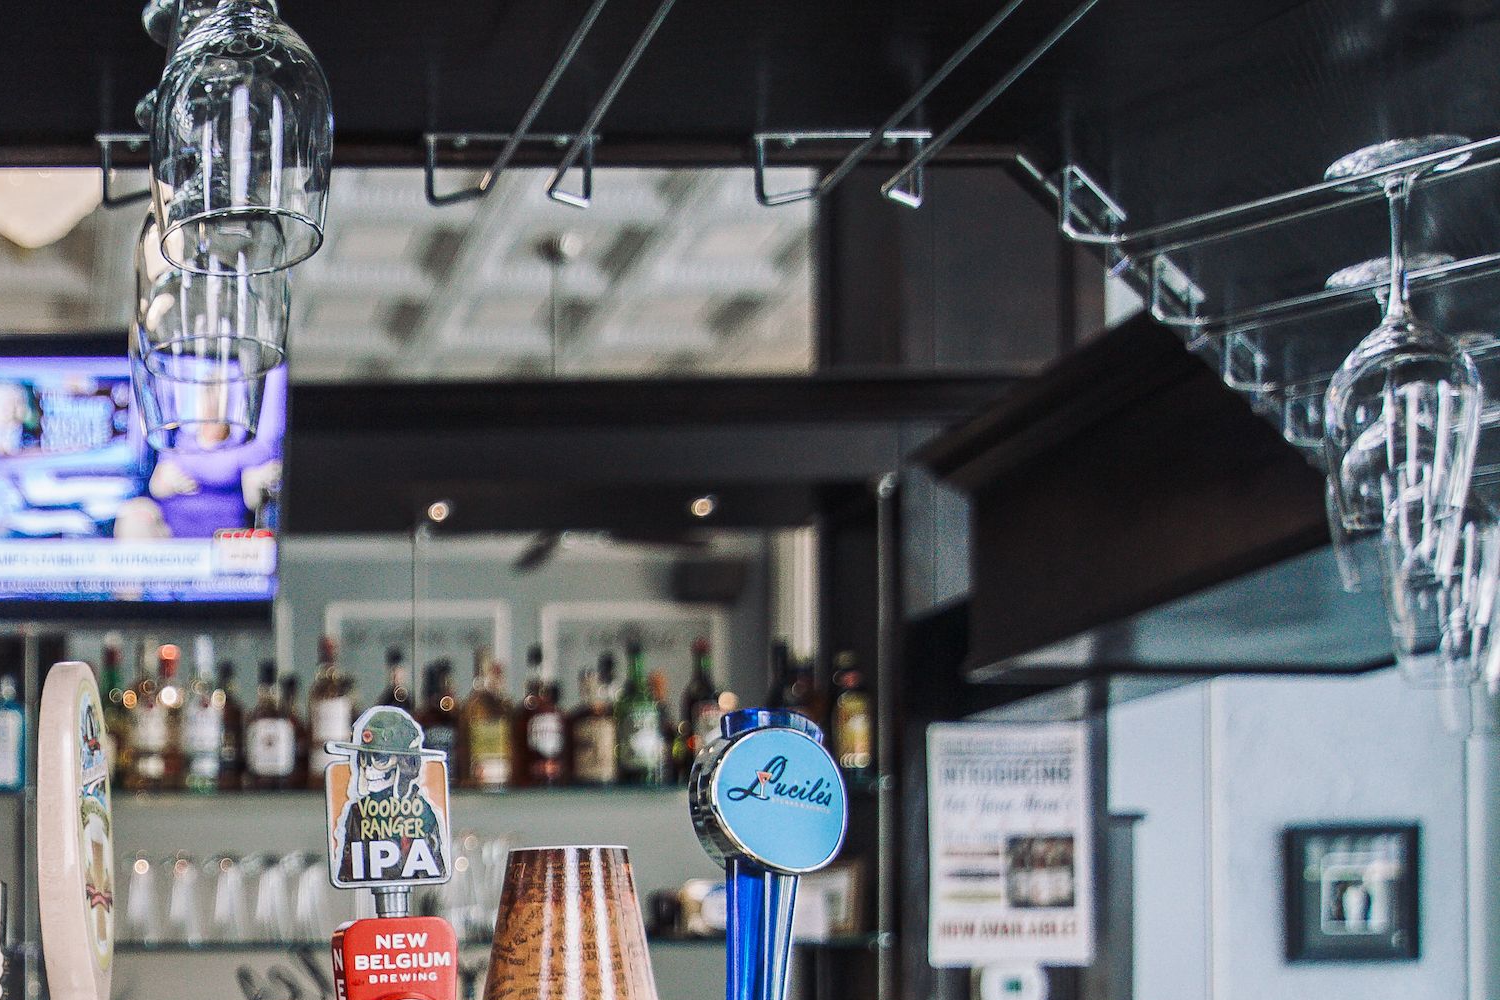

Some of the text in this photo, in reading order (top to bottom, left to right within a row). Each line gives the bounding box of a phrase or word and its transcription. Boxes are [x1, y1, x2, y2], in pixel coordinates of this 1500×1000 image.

[358, 797, 423, 818] VOODOO
[360, 817, 425, 840] RANGER
[350, 838, 440, 880] IPA
[375, 932, 429, 950] NEW
[354, 951, 451, 971] BELGIUM
[368, 971, 438, 984] BREWING
